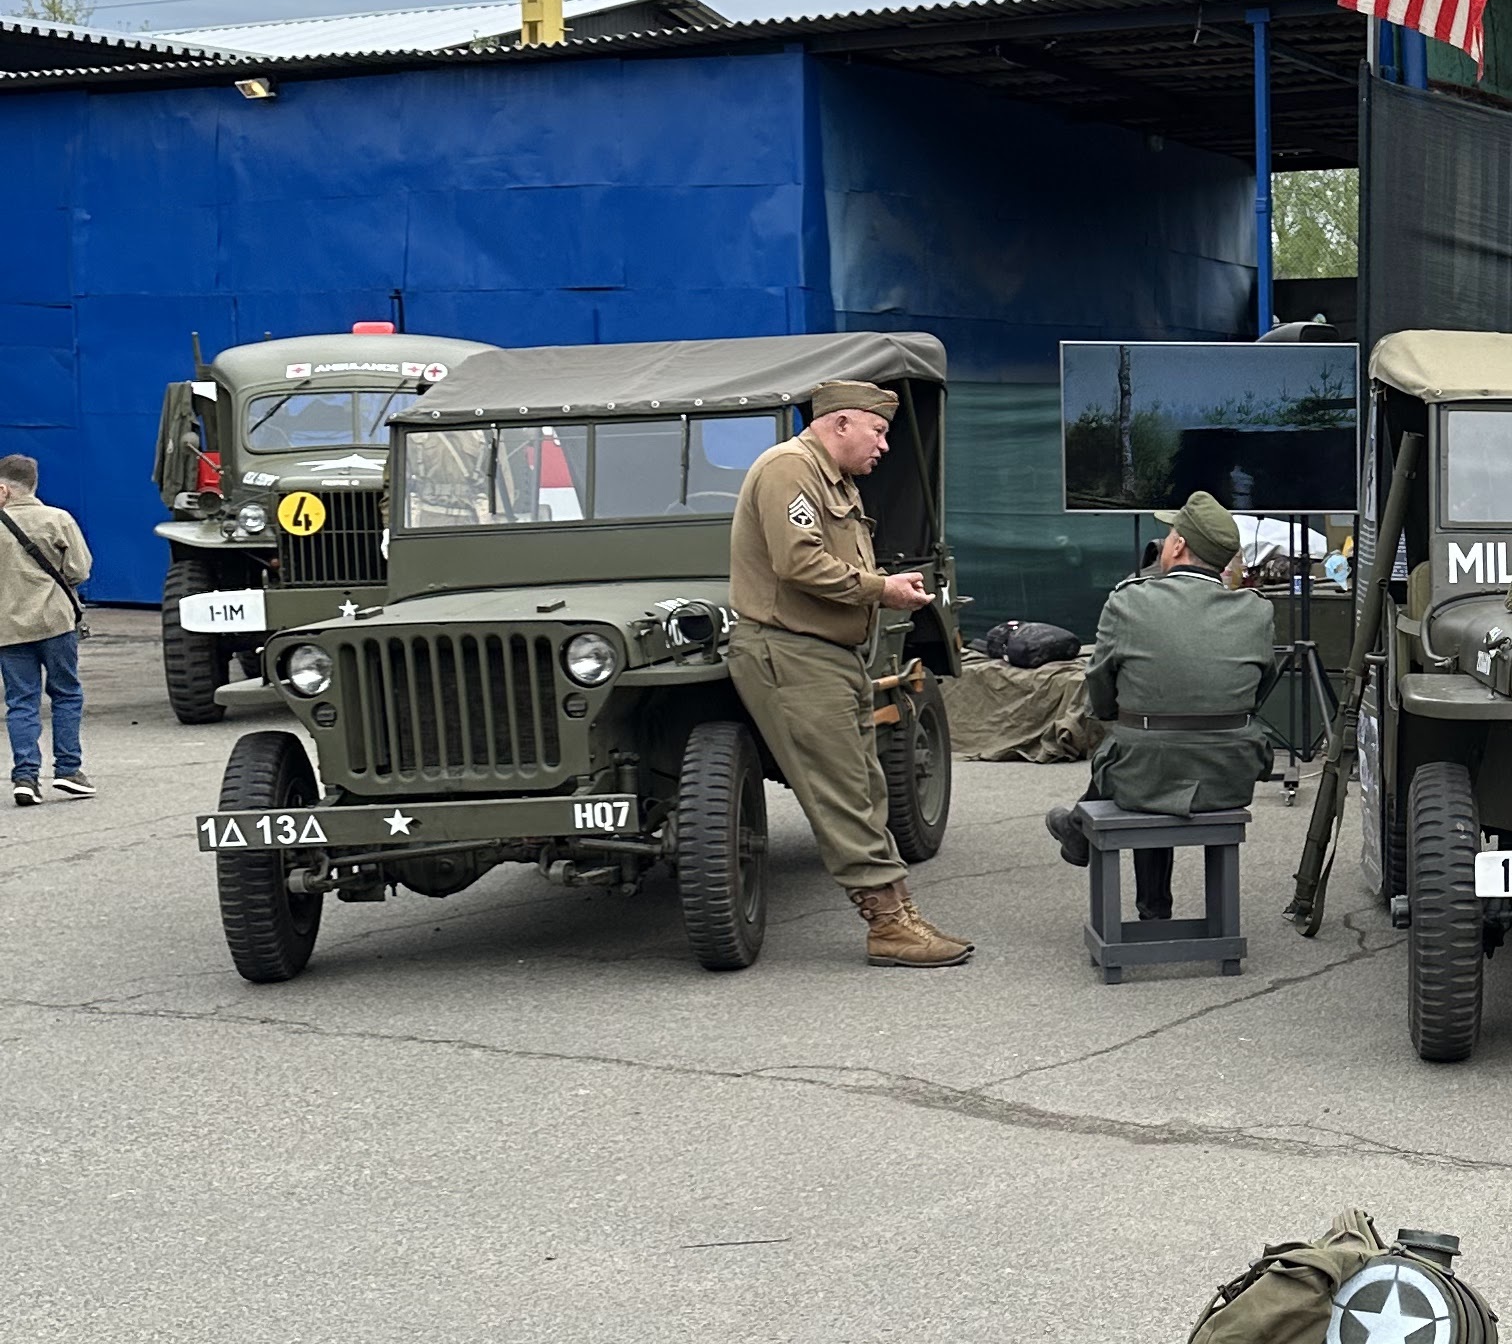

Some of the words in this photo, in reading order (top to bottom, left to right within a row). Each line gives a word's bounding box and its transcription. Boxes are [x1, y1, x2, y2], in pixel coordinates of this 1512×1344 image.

[292, 496, 312, 531] 4
[209, 604, 244, 622] 1-1M
[574, 801, 630, 831] HQ7
